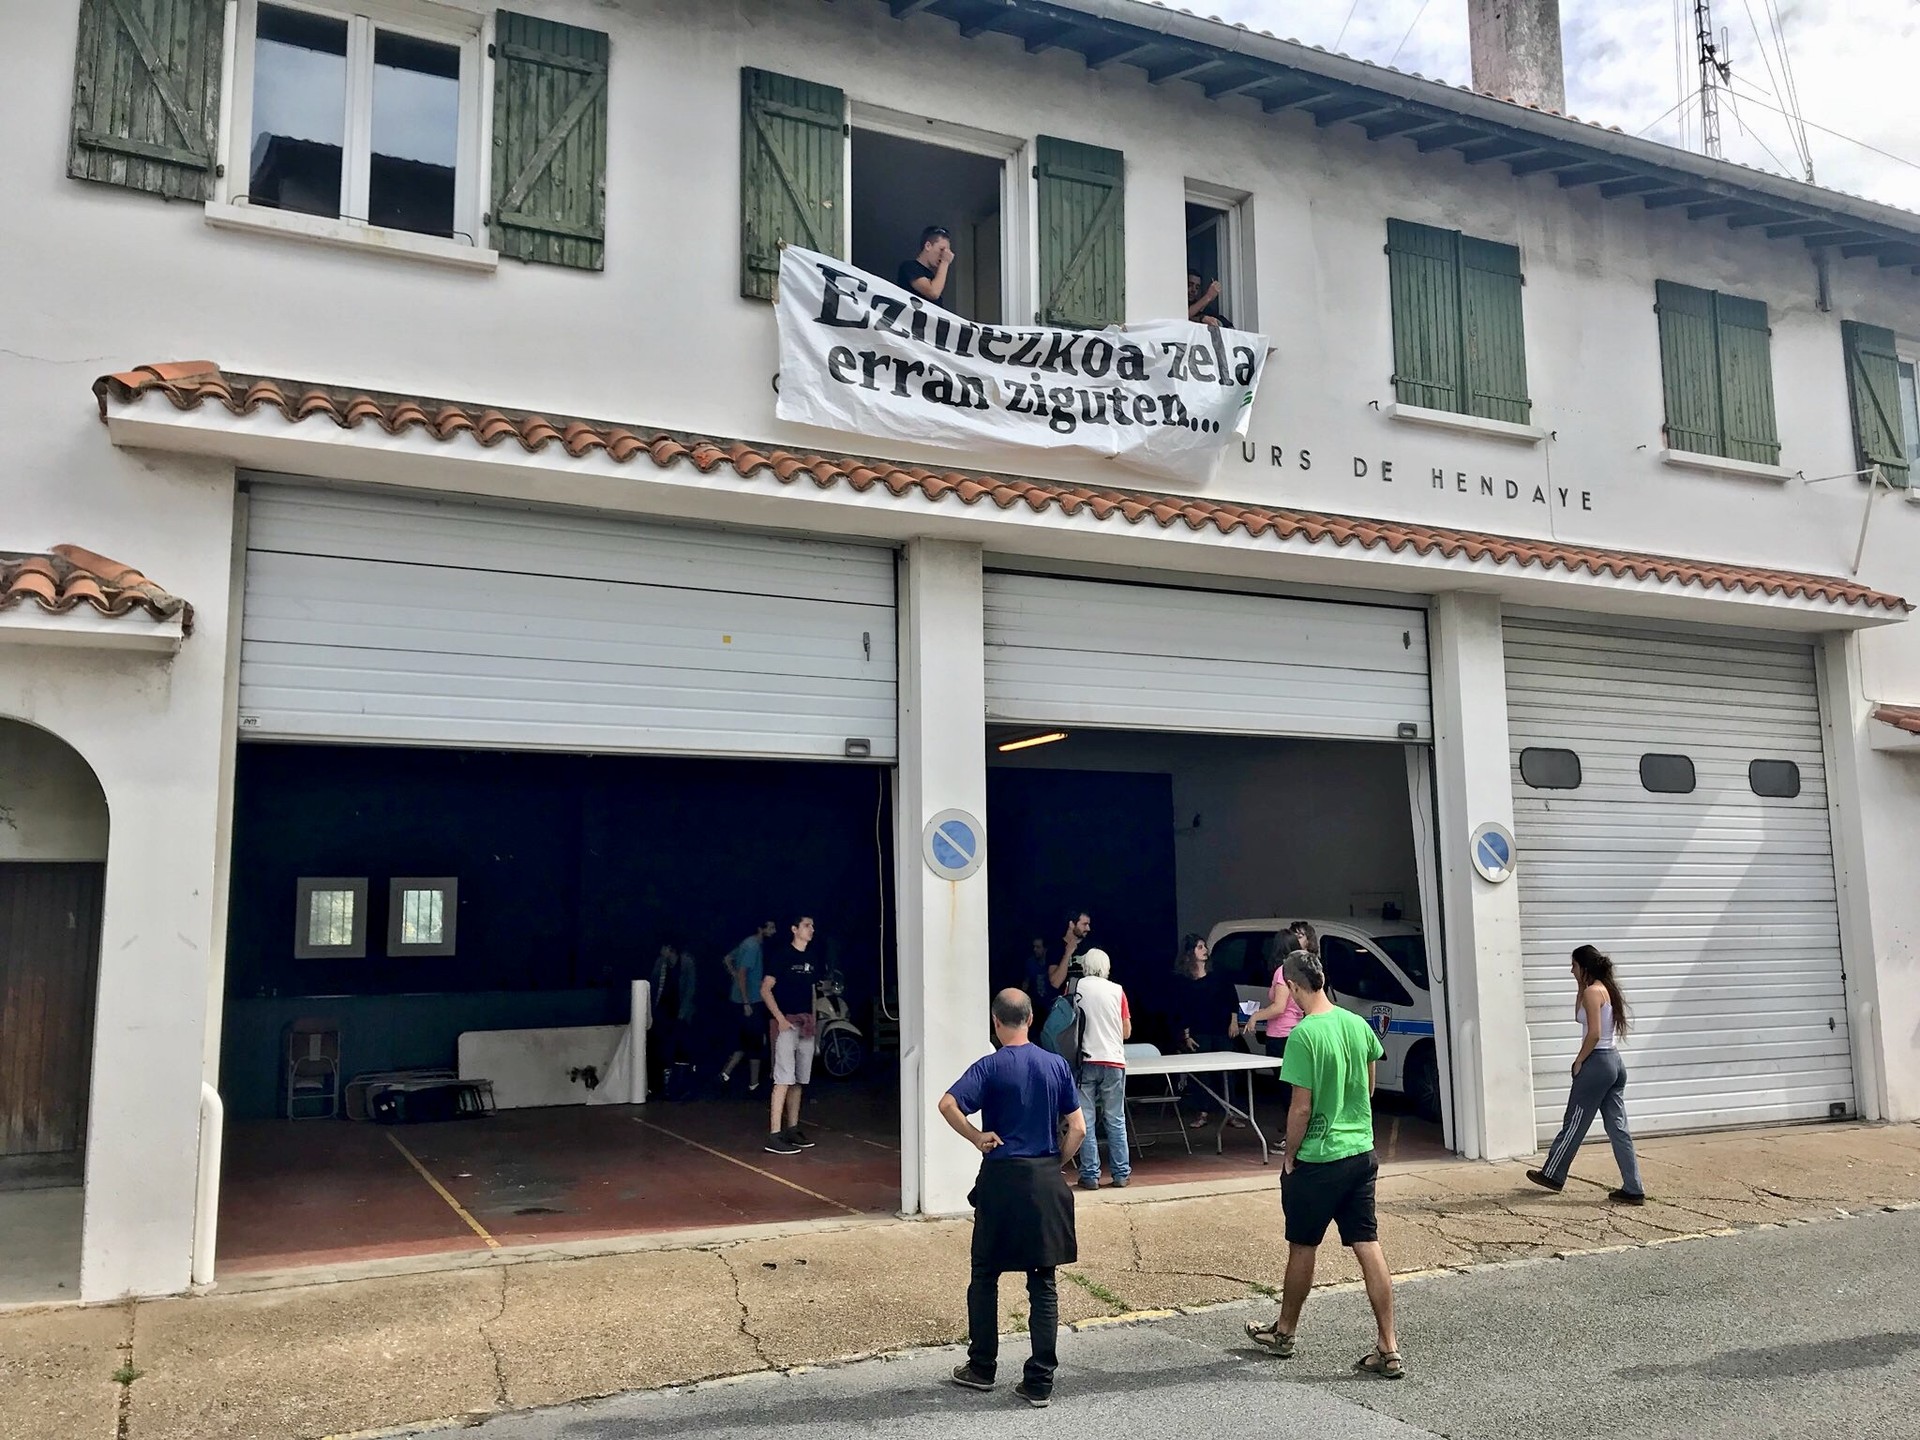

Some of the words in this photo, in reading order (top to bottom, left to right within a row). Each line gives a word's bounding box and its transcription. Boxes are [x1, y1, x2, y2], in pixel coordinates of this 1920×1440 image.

[828, 344, 990, 410] erran
[1003, 372, 1220, 434] ziguten...
[1160, 325, 1255, 386] zela
[1242, 441, 1311, 470] URS
[1353, 457, 1393, 482] DE
[1432, 468, 1592, 510] HENDAYE
